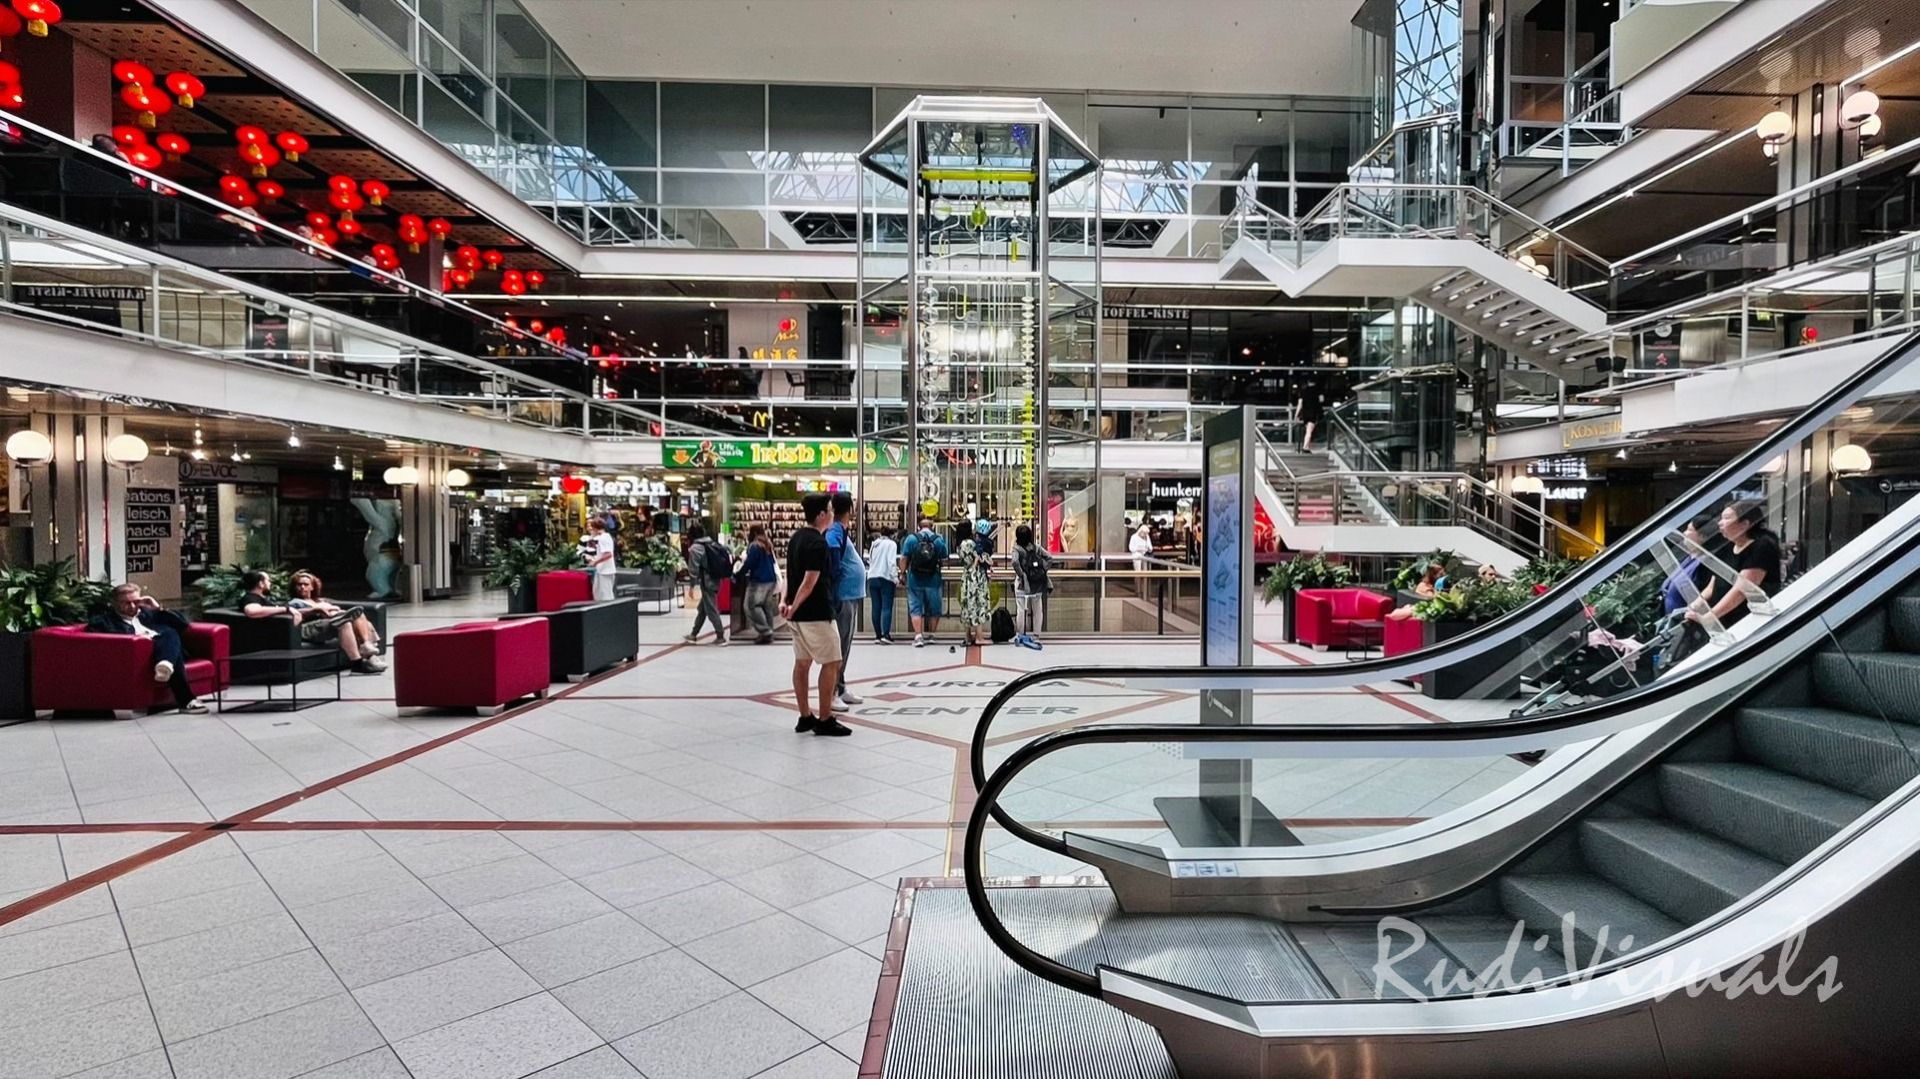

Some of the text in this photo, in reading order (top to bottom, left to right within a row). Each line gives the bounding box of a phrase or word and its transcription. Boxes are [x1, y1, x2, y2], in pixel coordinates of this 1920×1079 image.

[1077, 307, 1190, 319] KATOFFEL-KISTE
[750, 442, 877, 467] Irish Pub
[975, 448, 1039, 465] SATUR
[549, 477, 562, 496] I
[1544, 487, 1587, 500] LANET
[132, 541, 158, 553] und
[873, 680, 1071, 688] EUROA
